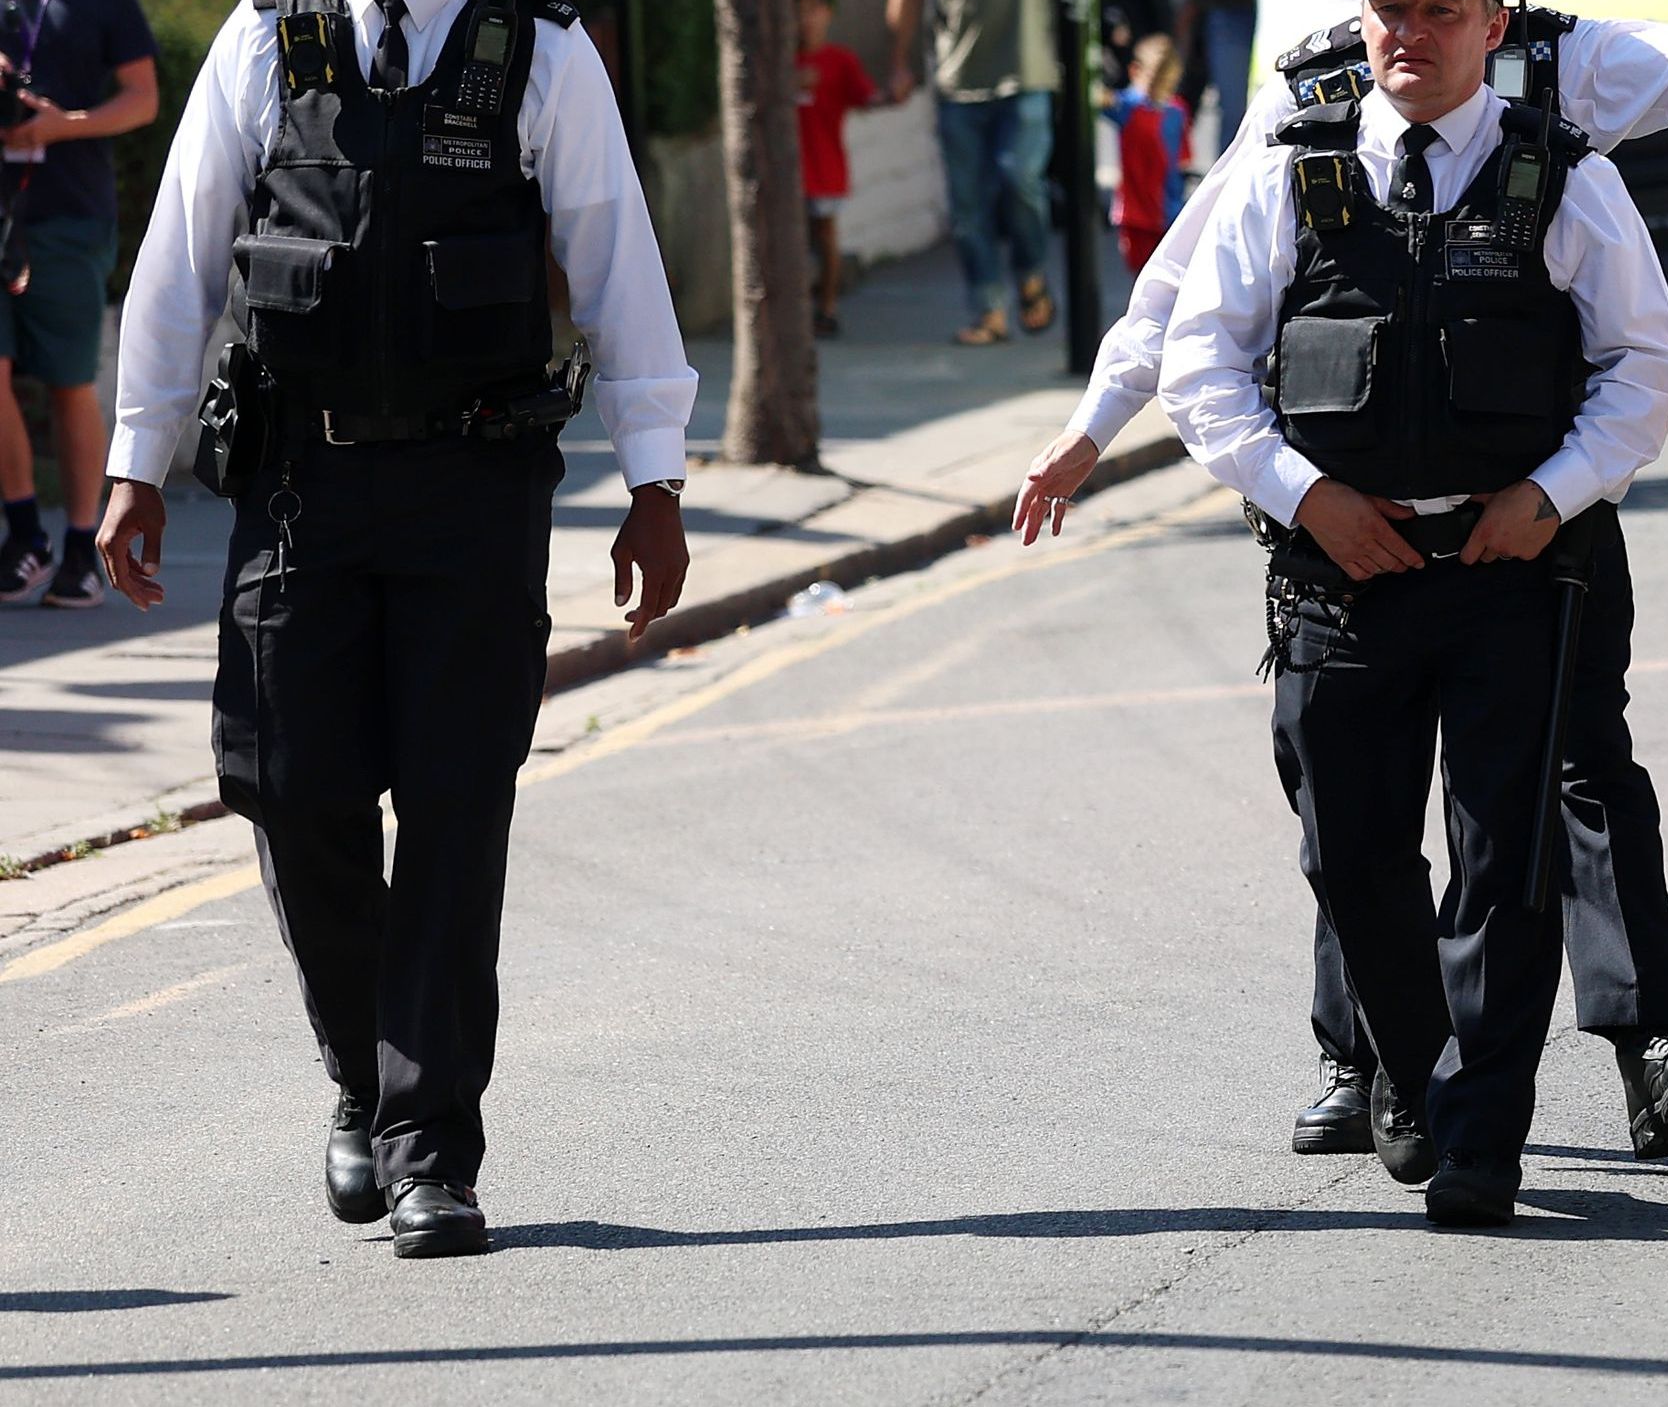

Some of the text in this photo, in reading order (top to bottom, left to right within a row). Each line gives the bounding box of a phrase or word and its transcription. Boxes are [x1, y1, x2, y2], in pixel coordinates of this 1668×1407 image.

[443, 139, 488, 148] METROPOLITAN
[449, 147, 482, 155] POLICE
[423, 155, 491, 169] POLICE OFFICER
[1452, 268, 1519, 278] POLICE OFFICER
